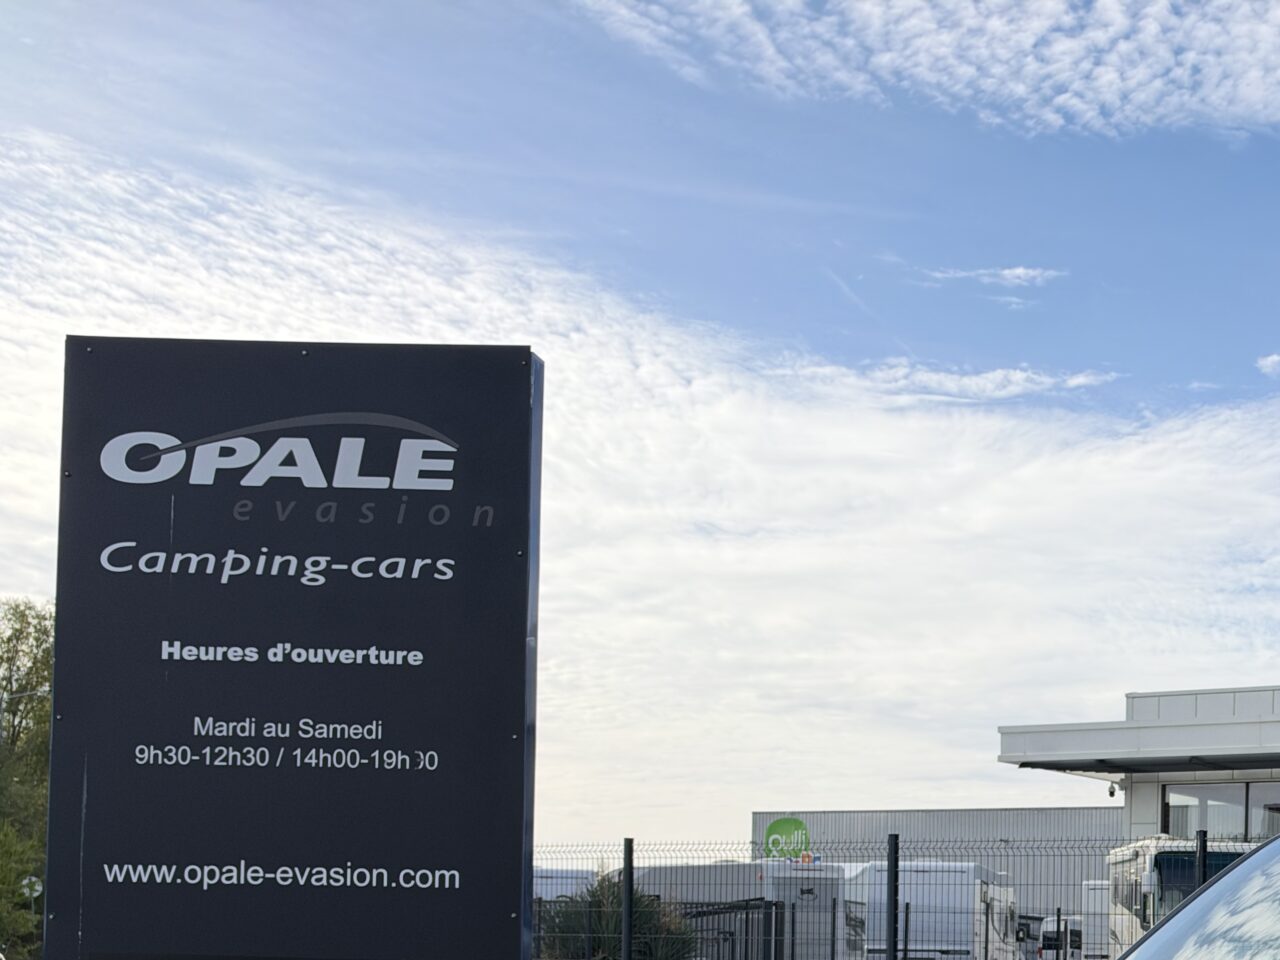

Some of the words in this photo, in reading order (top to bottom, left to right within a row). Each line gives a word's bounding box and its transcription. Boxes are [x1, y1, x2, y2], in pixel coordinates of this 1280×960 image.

[99, 431, 458, 491] OPALE
[232, 496, 494, 527] evasion
[99, 541, 456, 586] Camping-cars
[161, 640, 260, 662] Heures
[267, 642, 424, 666] d'ouverture
[193, 716, 256, 737] Mardi
[262, 722, 290, 738] au
[297, 718, 382, 740] Samedi
[134, 744, 270, 767] 9h30-12h30
[103, 859, 460, 891] www.opale-evasion.com
